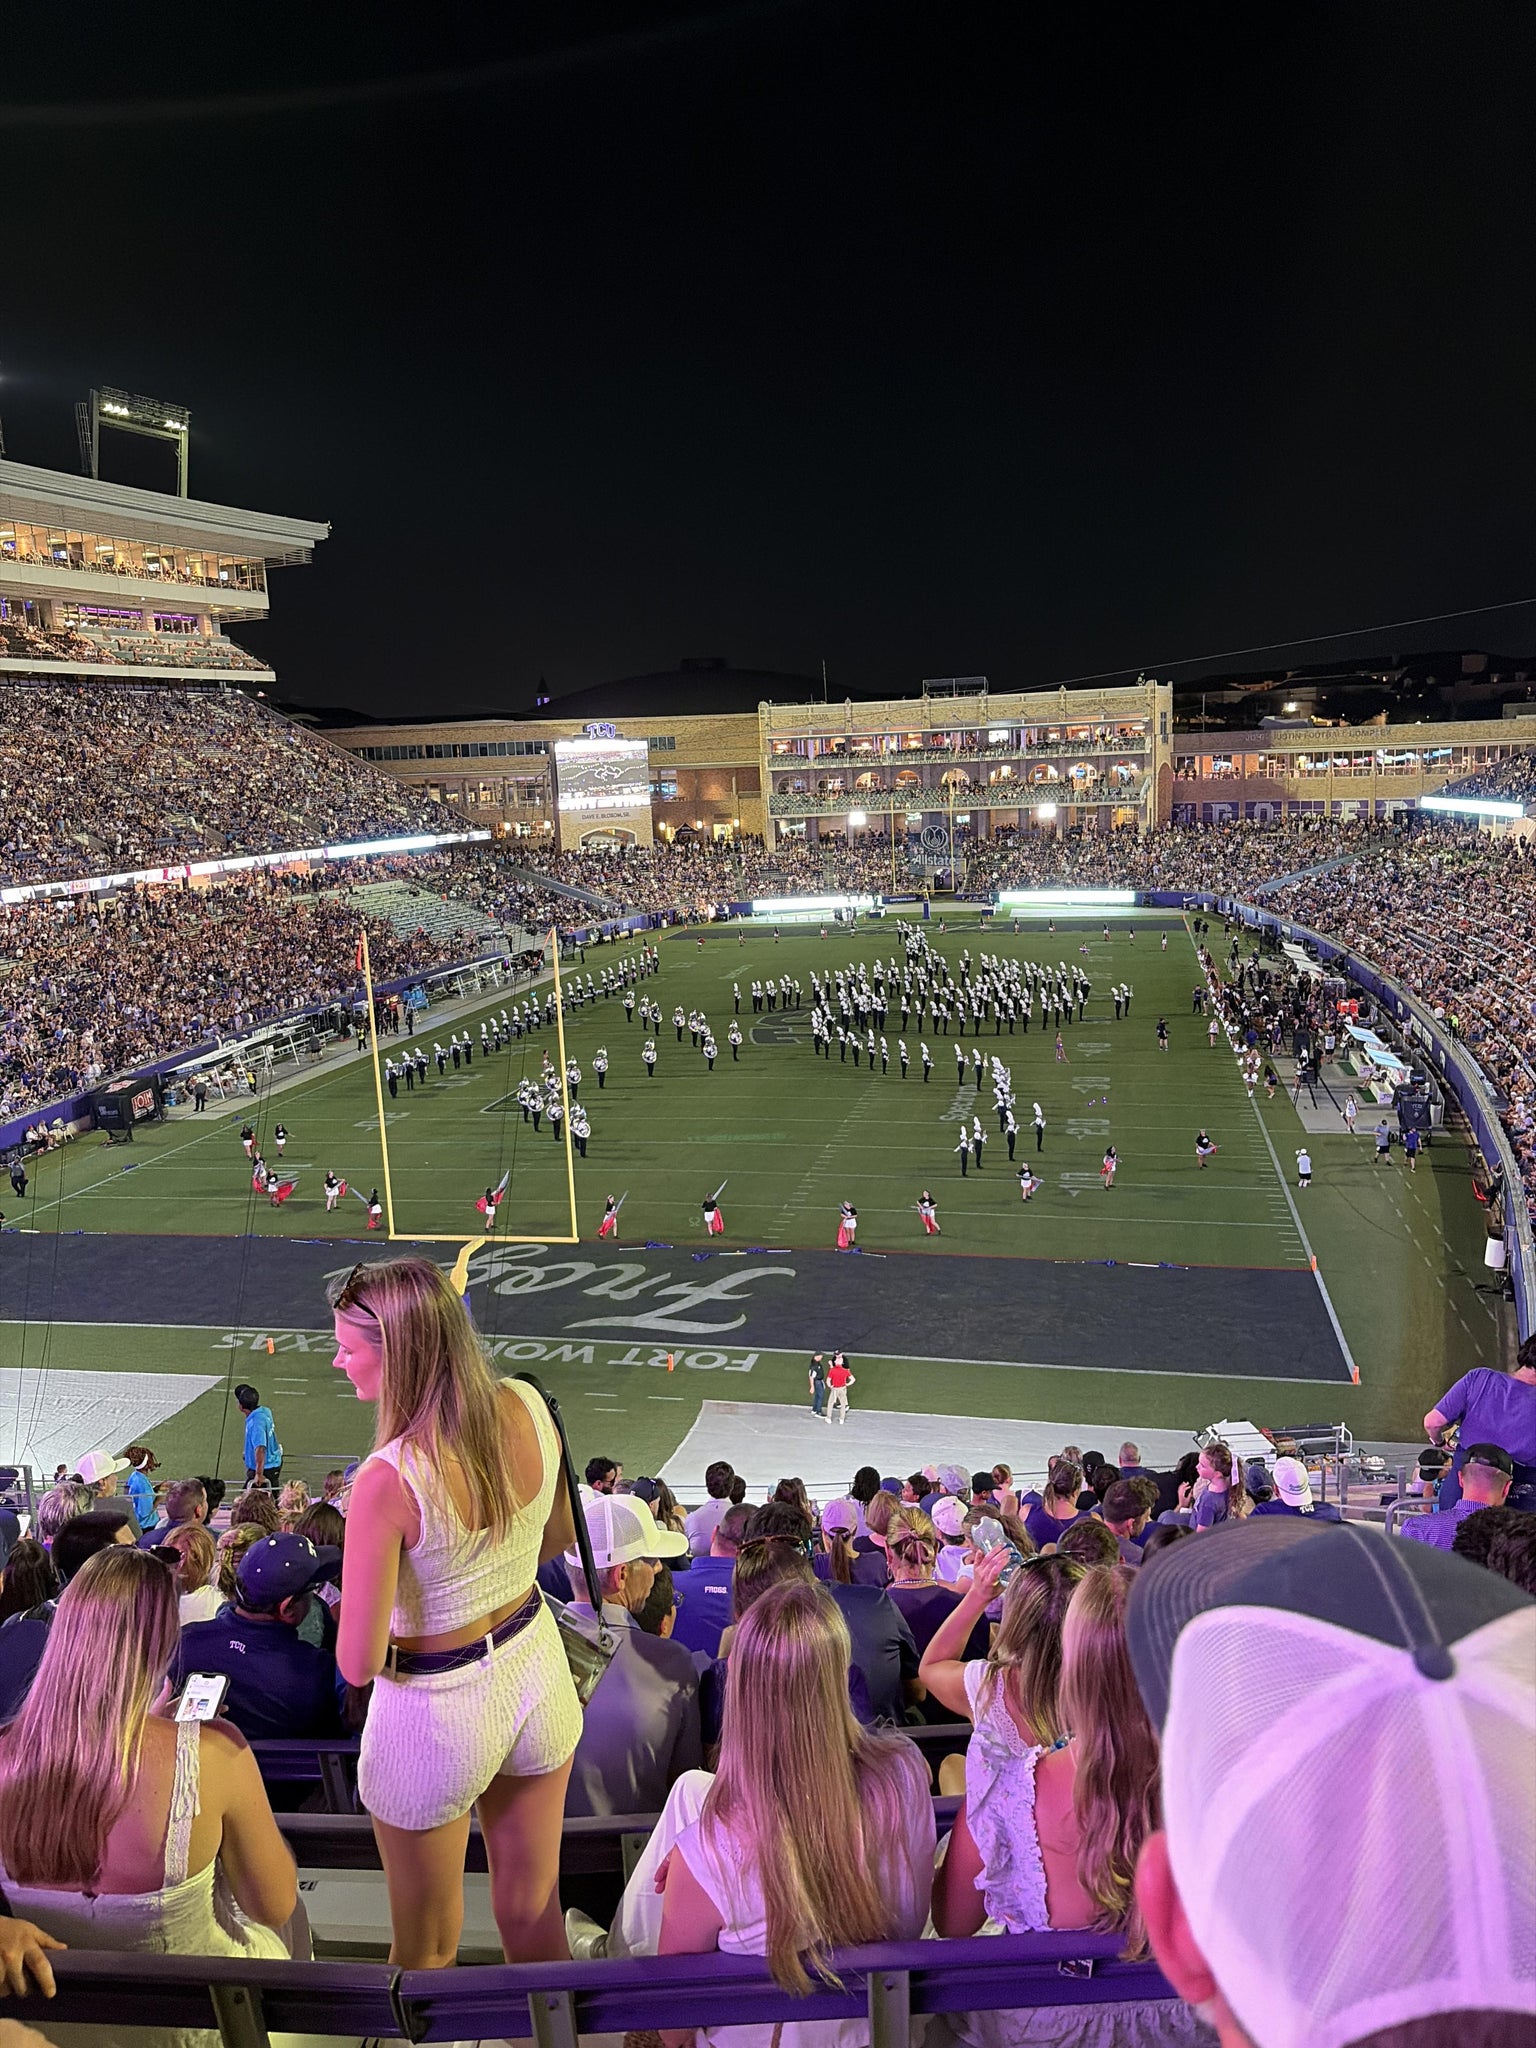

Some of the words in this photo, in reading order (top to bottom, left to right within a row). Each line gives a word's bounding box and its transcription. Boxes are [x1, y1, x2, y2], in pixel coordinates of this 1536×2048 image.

[587, 723, 616, 739] TCU
[913, 854, 957, 866] Allstate
[607, 1347, 759, 1373] FORT
